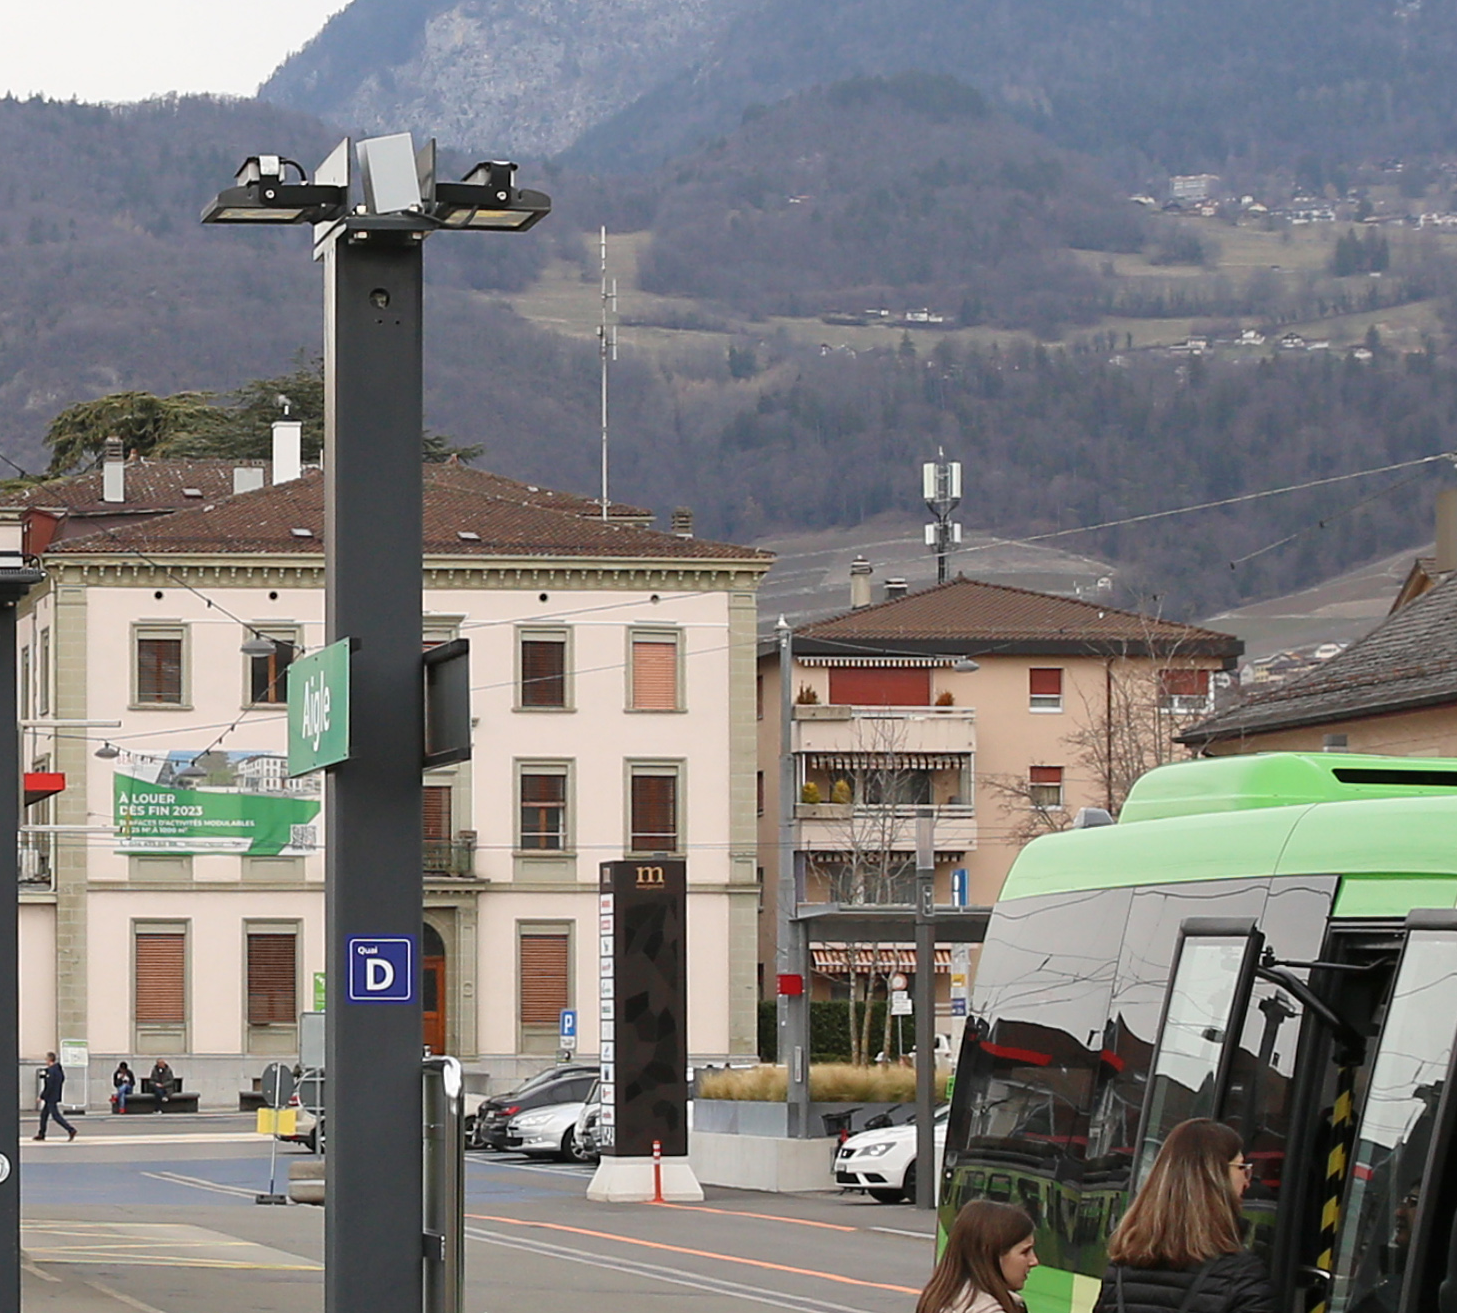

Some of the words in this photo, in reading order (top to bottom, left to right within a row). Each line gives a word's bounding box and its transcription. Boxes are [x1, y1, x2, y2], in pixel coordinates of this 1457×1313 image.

[301, 669, 331, 753] Aigle
[119, 791, 129, 804] À
[132, 793, 176, 804] LOUER
[148, 805, 170, 816] FIN
[172, 805, 203, 817] 2023
[357, 946, 378, 955] Quai
[366, 958, 394, 991] D
[564, 1014, 573, 1035] P
